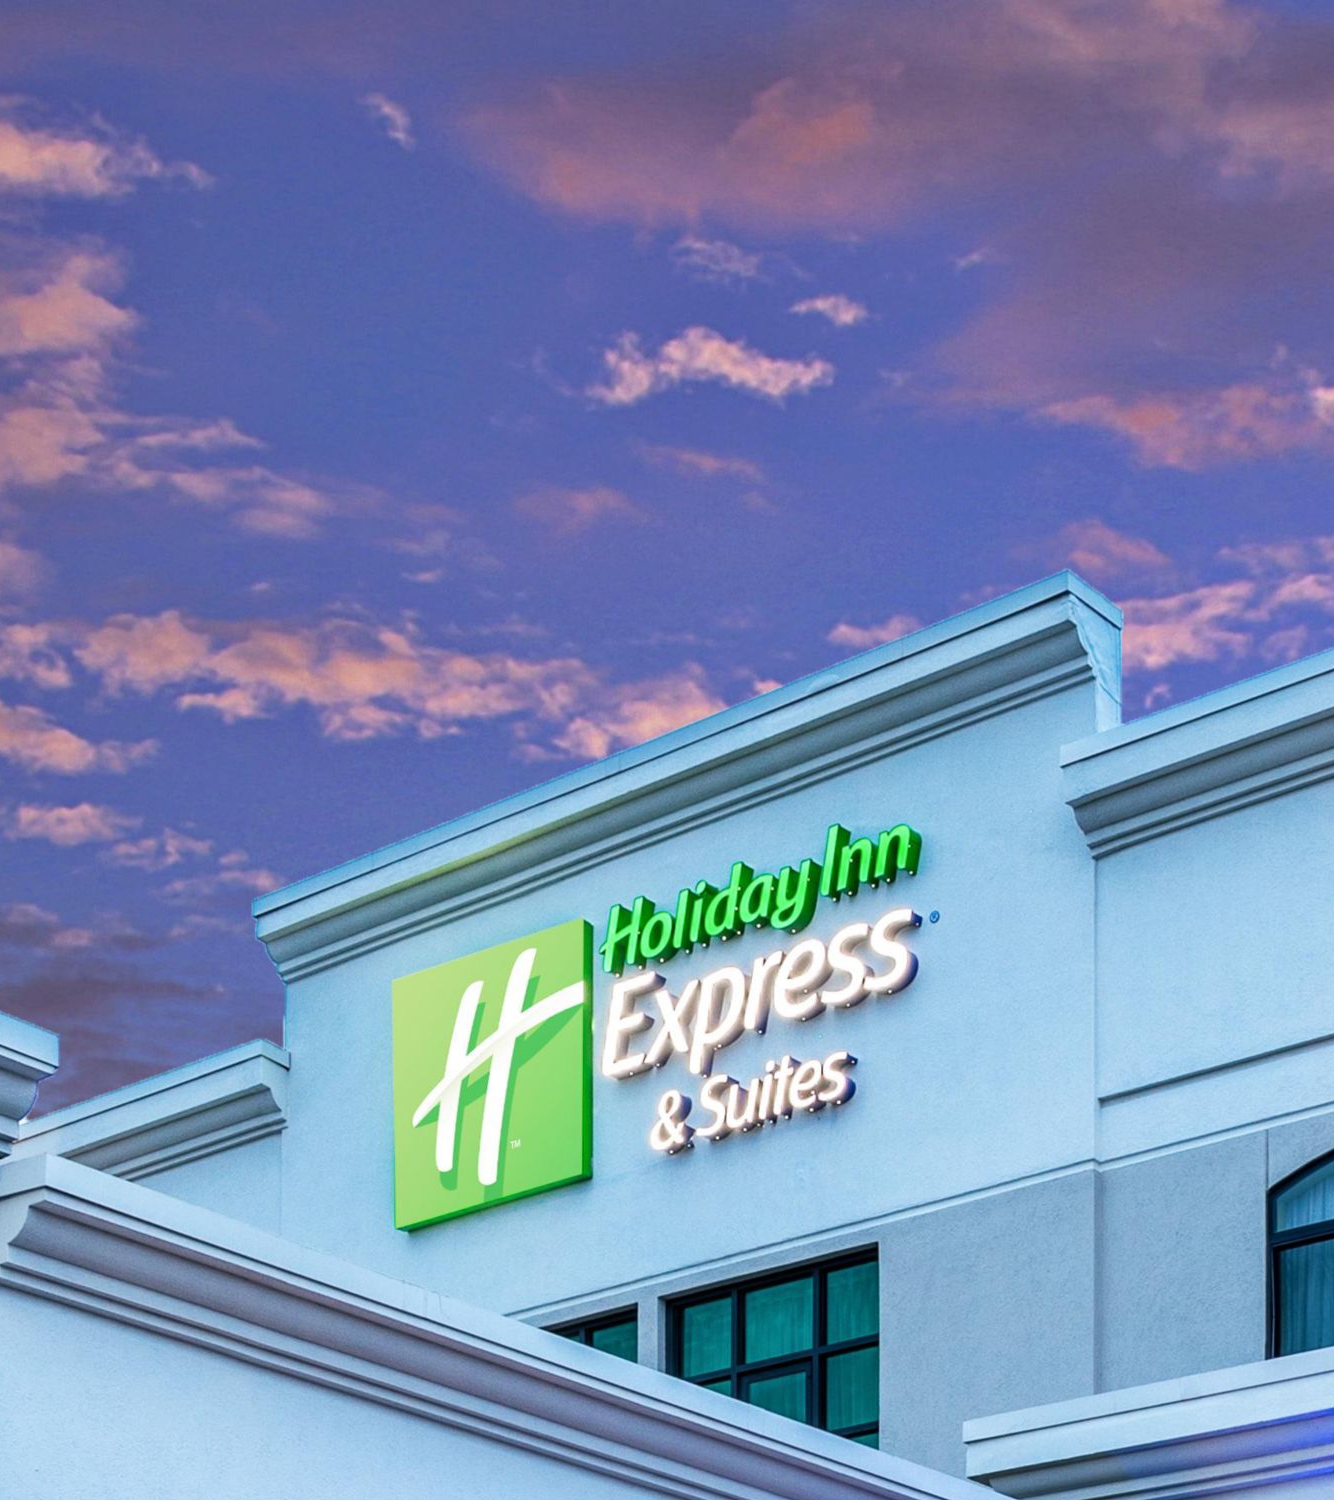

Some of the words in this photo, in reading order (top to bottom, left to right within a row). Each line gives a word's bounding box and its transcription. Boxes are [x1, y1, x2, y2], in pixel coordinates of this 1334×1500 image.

[600, 861, 822, 975] Holiday
[819, 823, 922, 901] Inn
[601, 908, 921, 1078] Express
[650, 1089, 694, 1153] &
[695, 1052, 857, 1139] Suites
